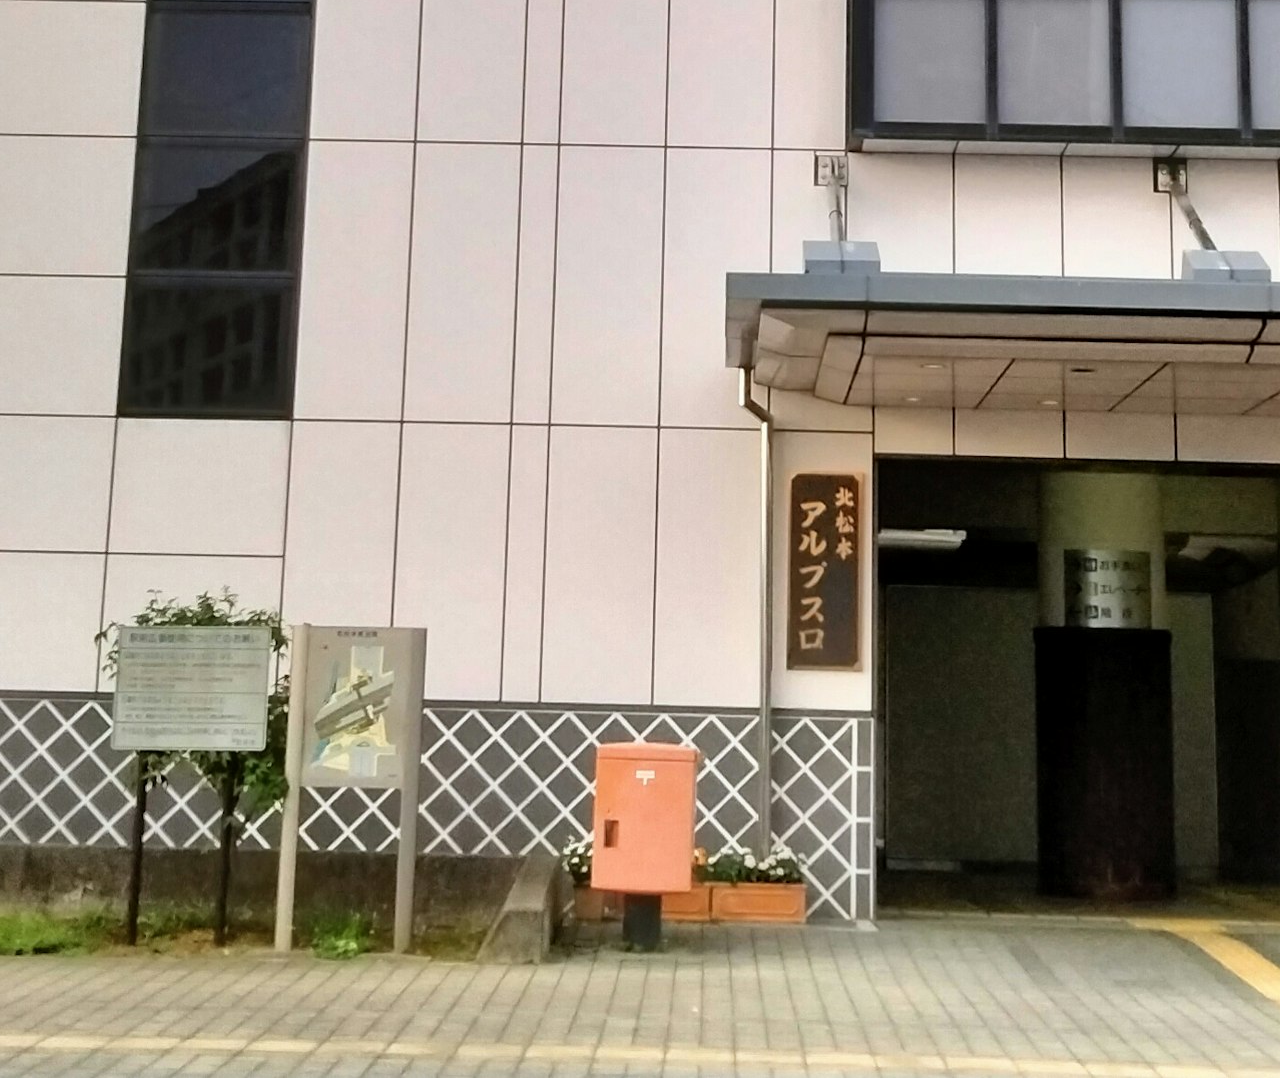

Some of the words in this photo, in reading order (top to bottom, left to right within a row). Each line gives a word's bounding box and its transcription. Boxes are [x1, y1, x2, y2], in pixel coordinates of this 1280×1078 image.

[797, 499, 829, 651] アルプス口
[834, 485, 855, 562] 北松本
